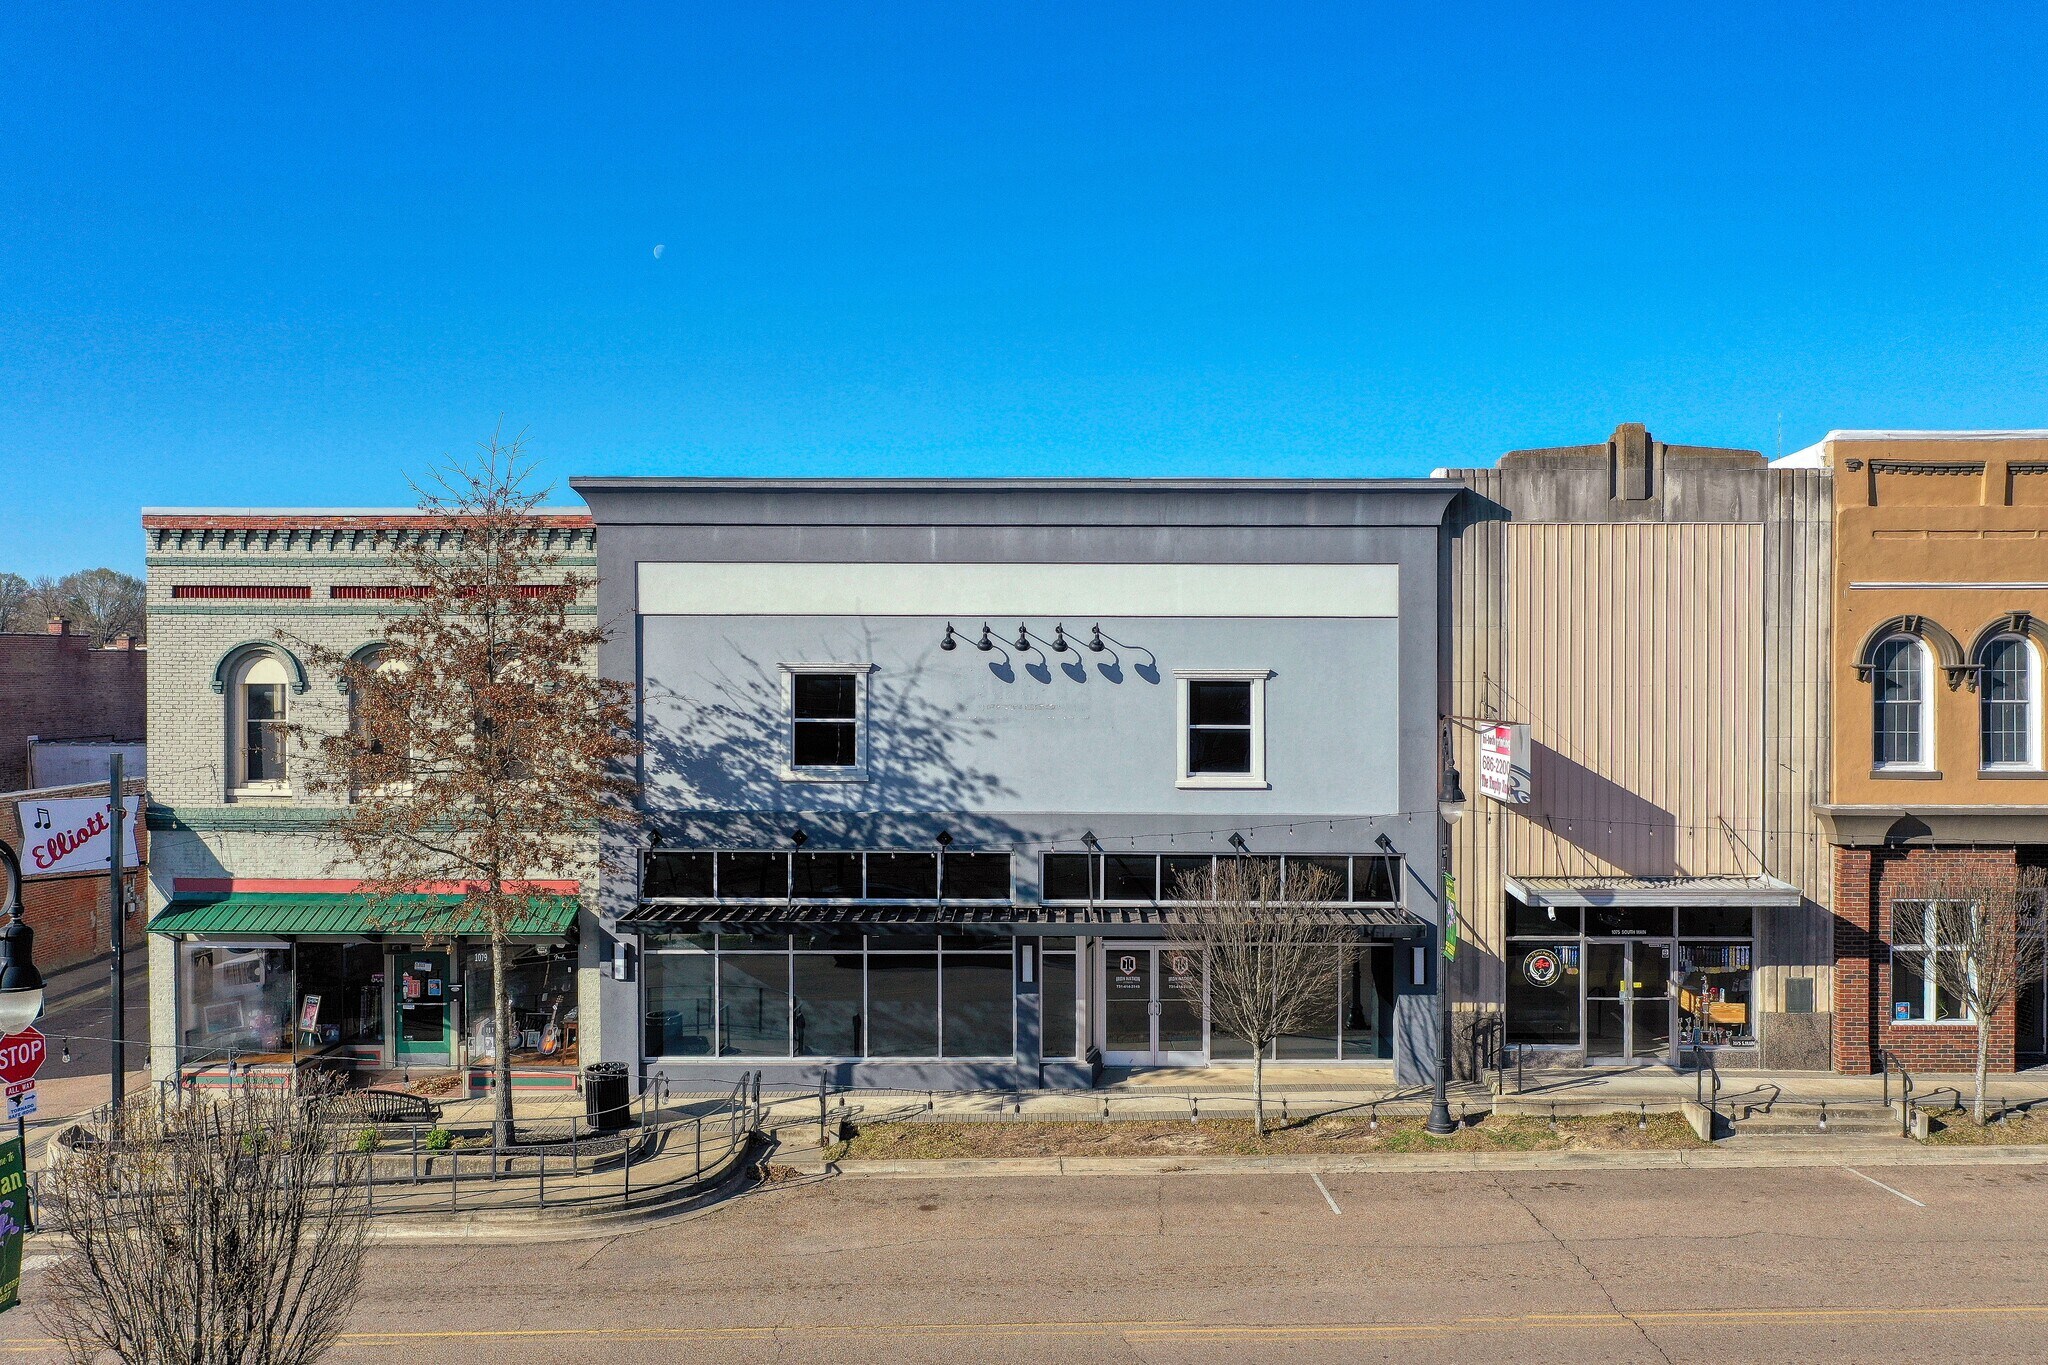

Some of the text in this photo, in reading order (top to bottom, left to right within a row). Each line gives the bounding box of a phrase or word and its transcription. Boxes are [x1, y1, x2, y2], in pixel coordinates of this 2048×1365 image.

[1482, 755, 1510, 776] 686-2200
[474, 953, 488, 962] 1079
[0, 1040, 42, 1070] STOP
[8, 1081, 33, 1095] ALL WAY
[11, 1103, 34, 1114] TORNADO
